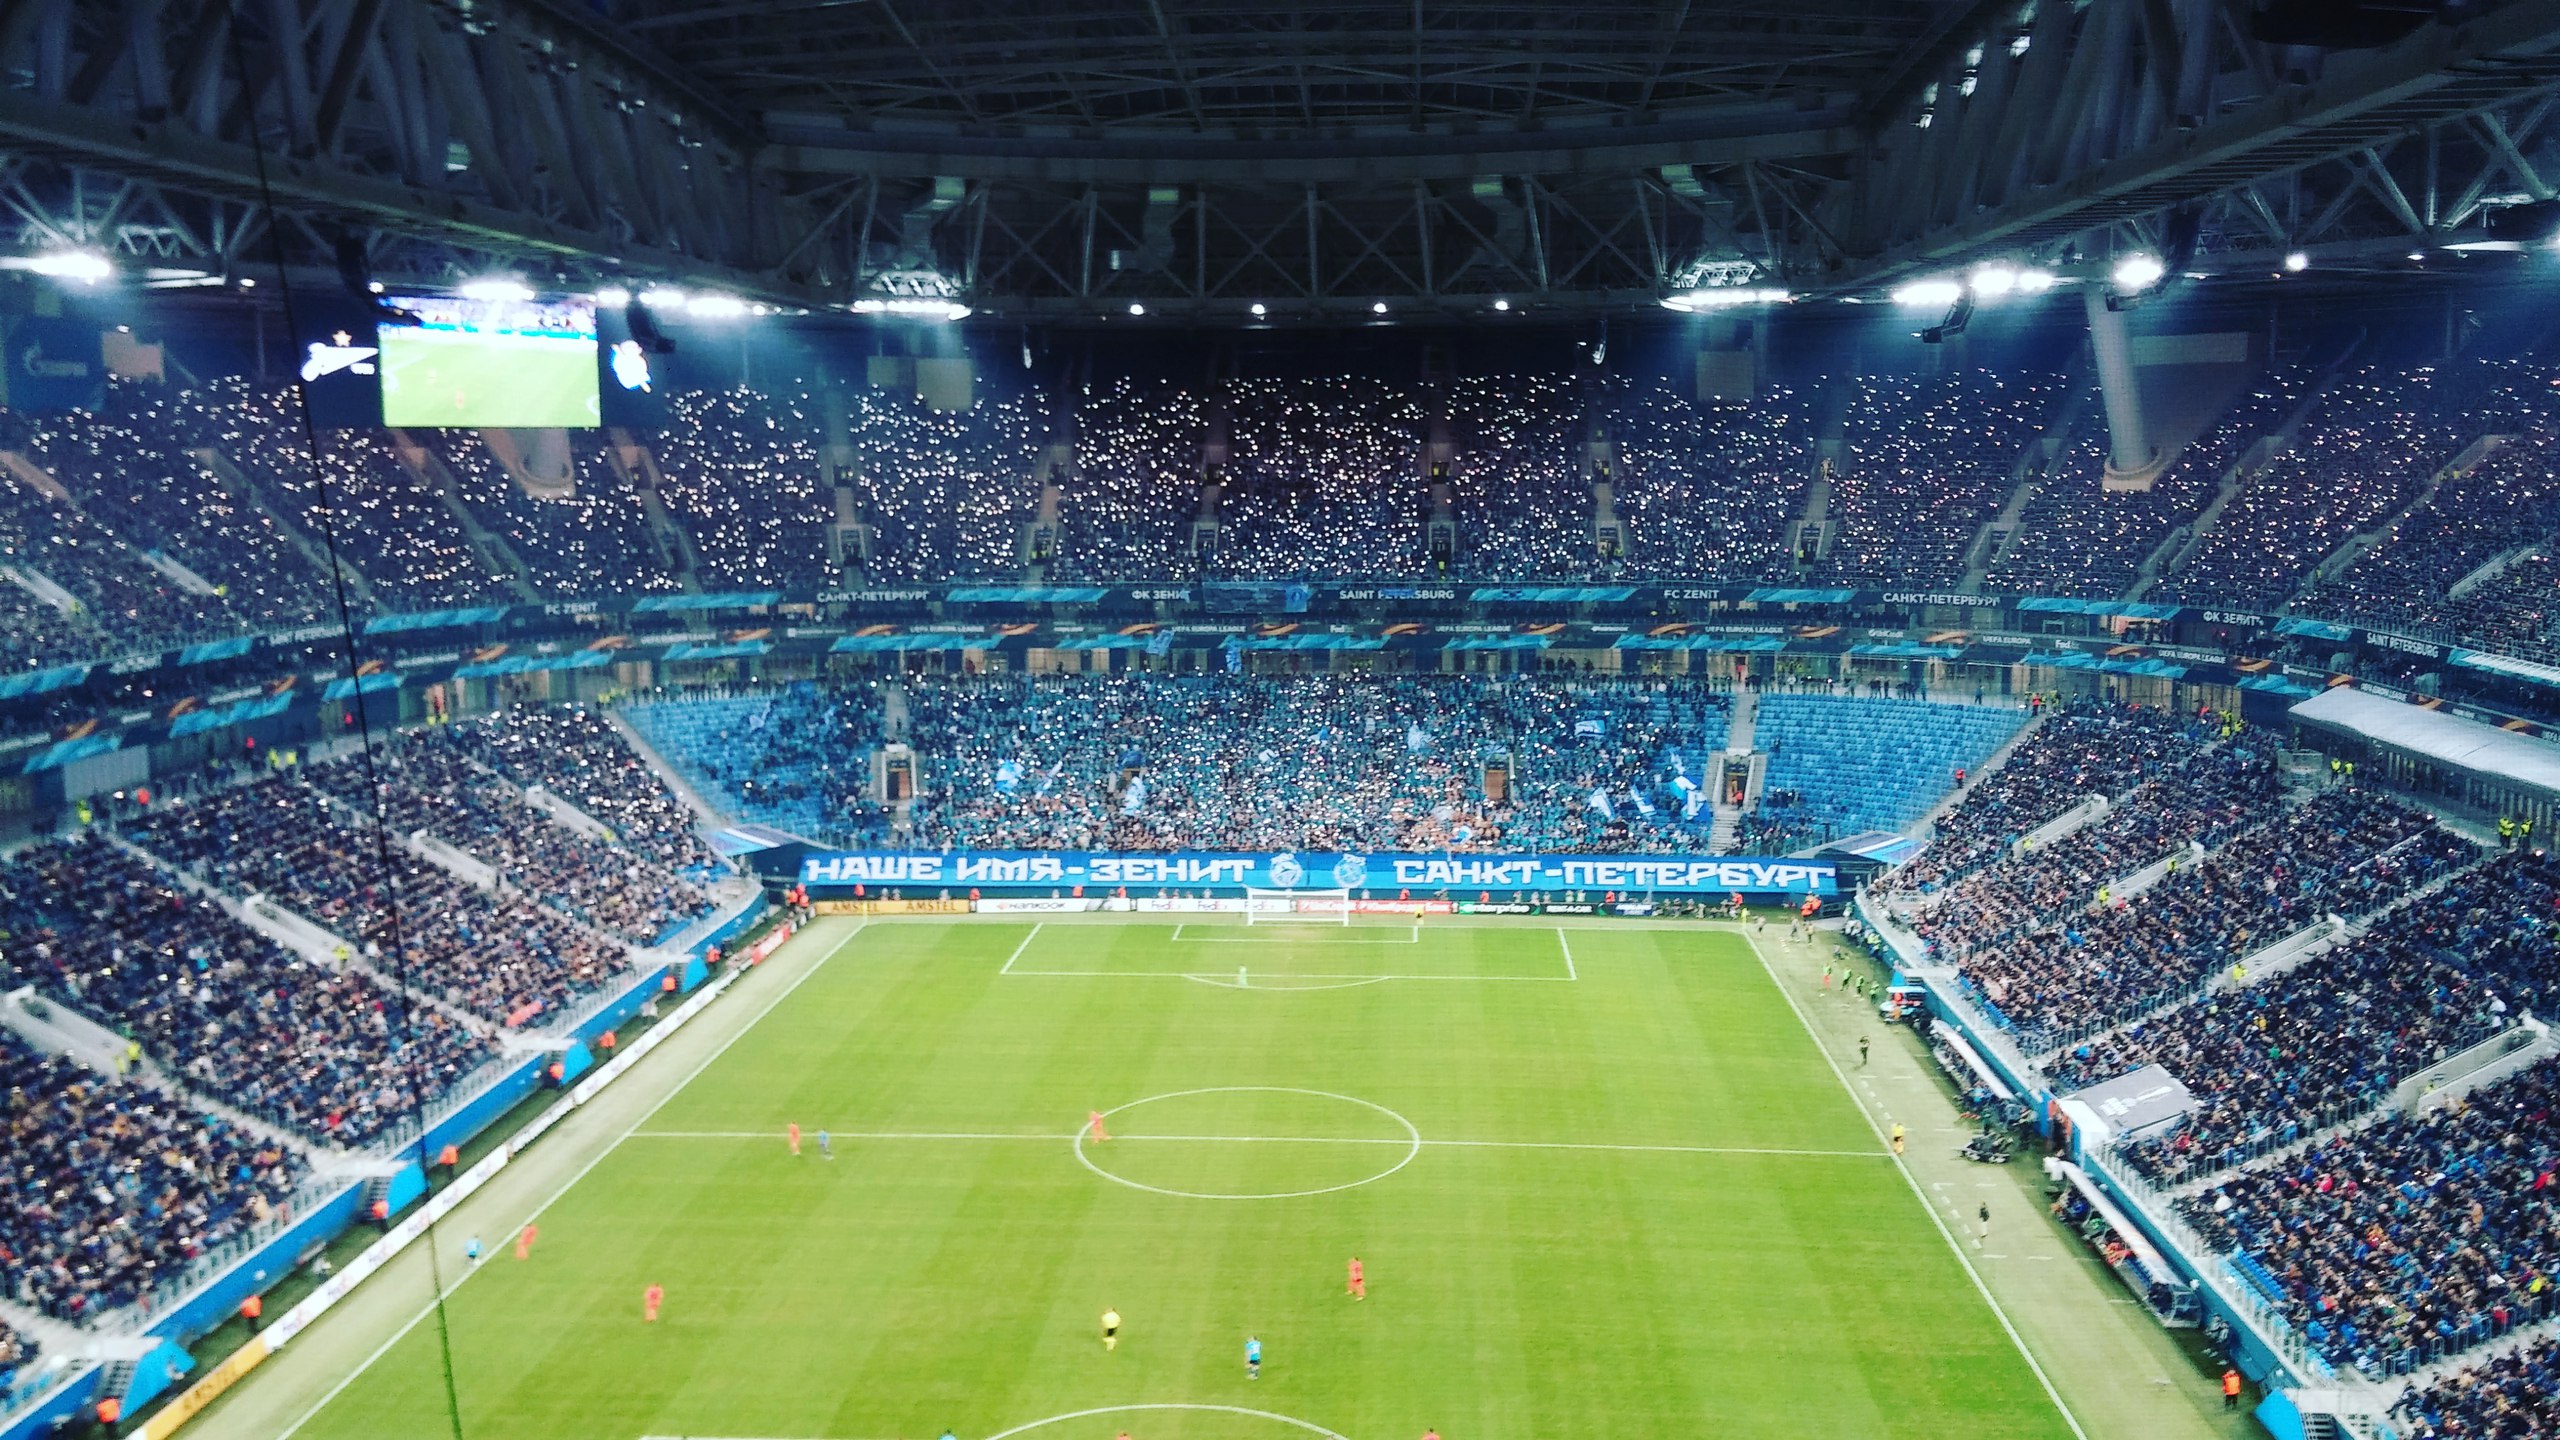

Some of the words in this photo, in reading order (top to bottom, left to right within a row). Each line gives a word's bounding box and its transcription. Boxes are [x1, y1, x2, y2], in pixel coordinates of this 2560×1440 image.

[817, 590, 929, 603] САНКТ-ПЕТЕРБУРГ
[1132, 589, 1150, 600] ФК
[1340, 589, 1375, 600] SAINT
[1664, 589, 1681, 600] FC
[1684, 589, 1720, 600] ZENIT
[1883, 592, 2000, 607] САНКТ-ПЕТЕРБУРГ
[2203, 610, 2220, 622] ФК
[804, 856, 943, 882] НАШЕ
[1393, 860, 1836, 889] САНКТ-ПЕТЕРБУРГ
[905, 901, 957, 912] AMSTEL
